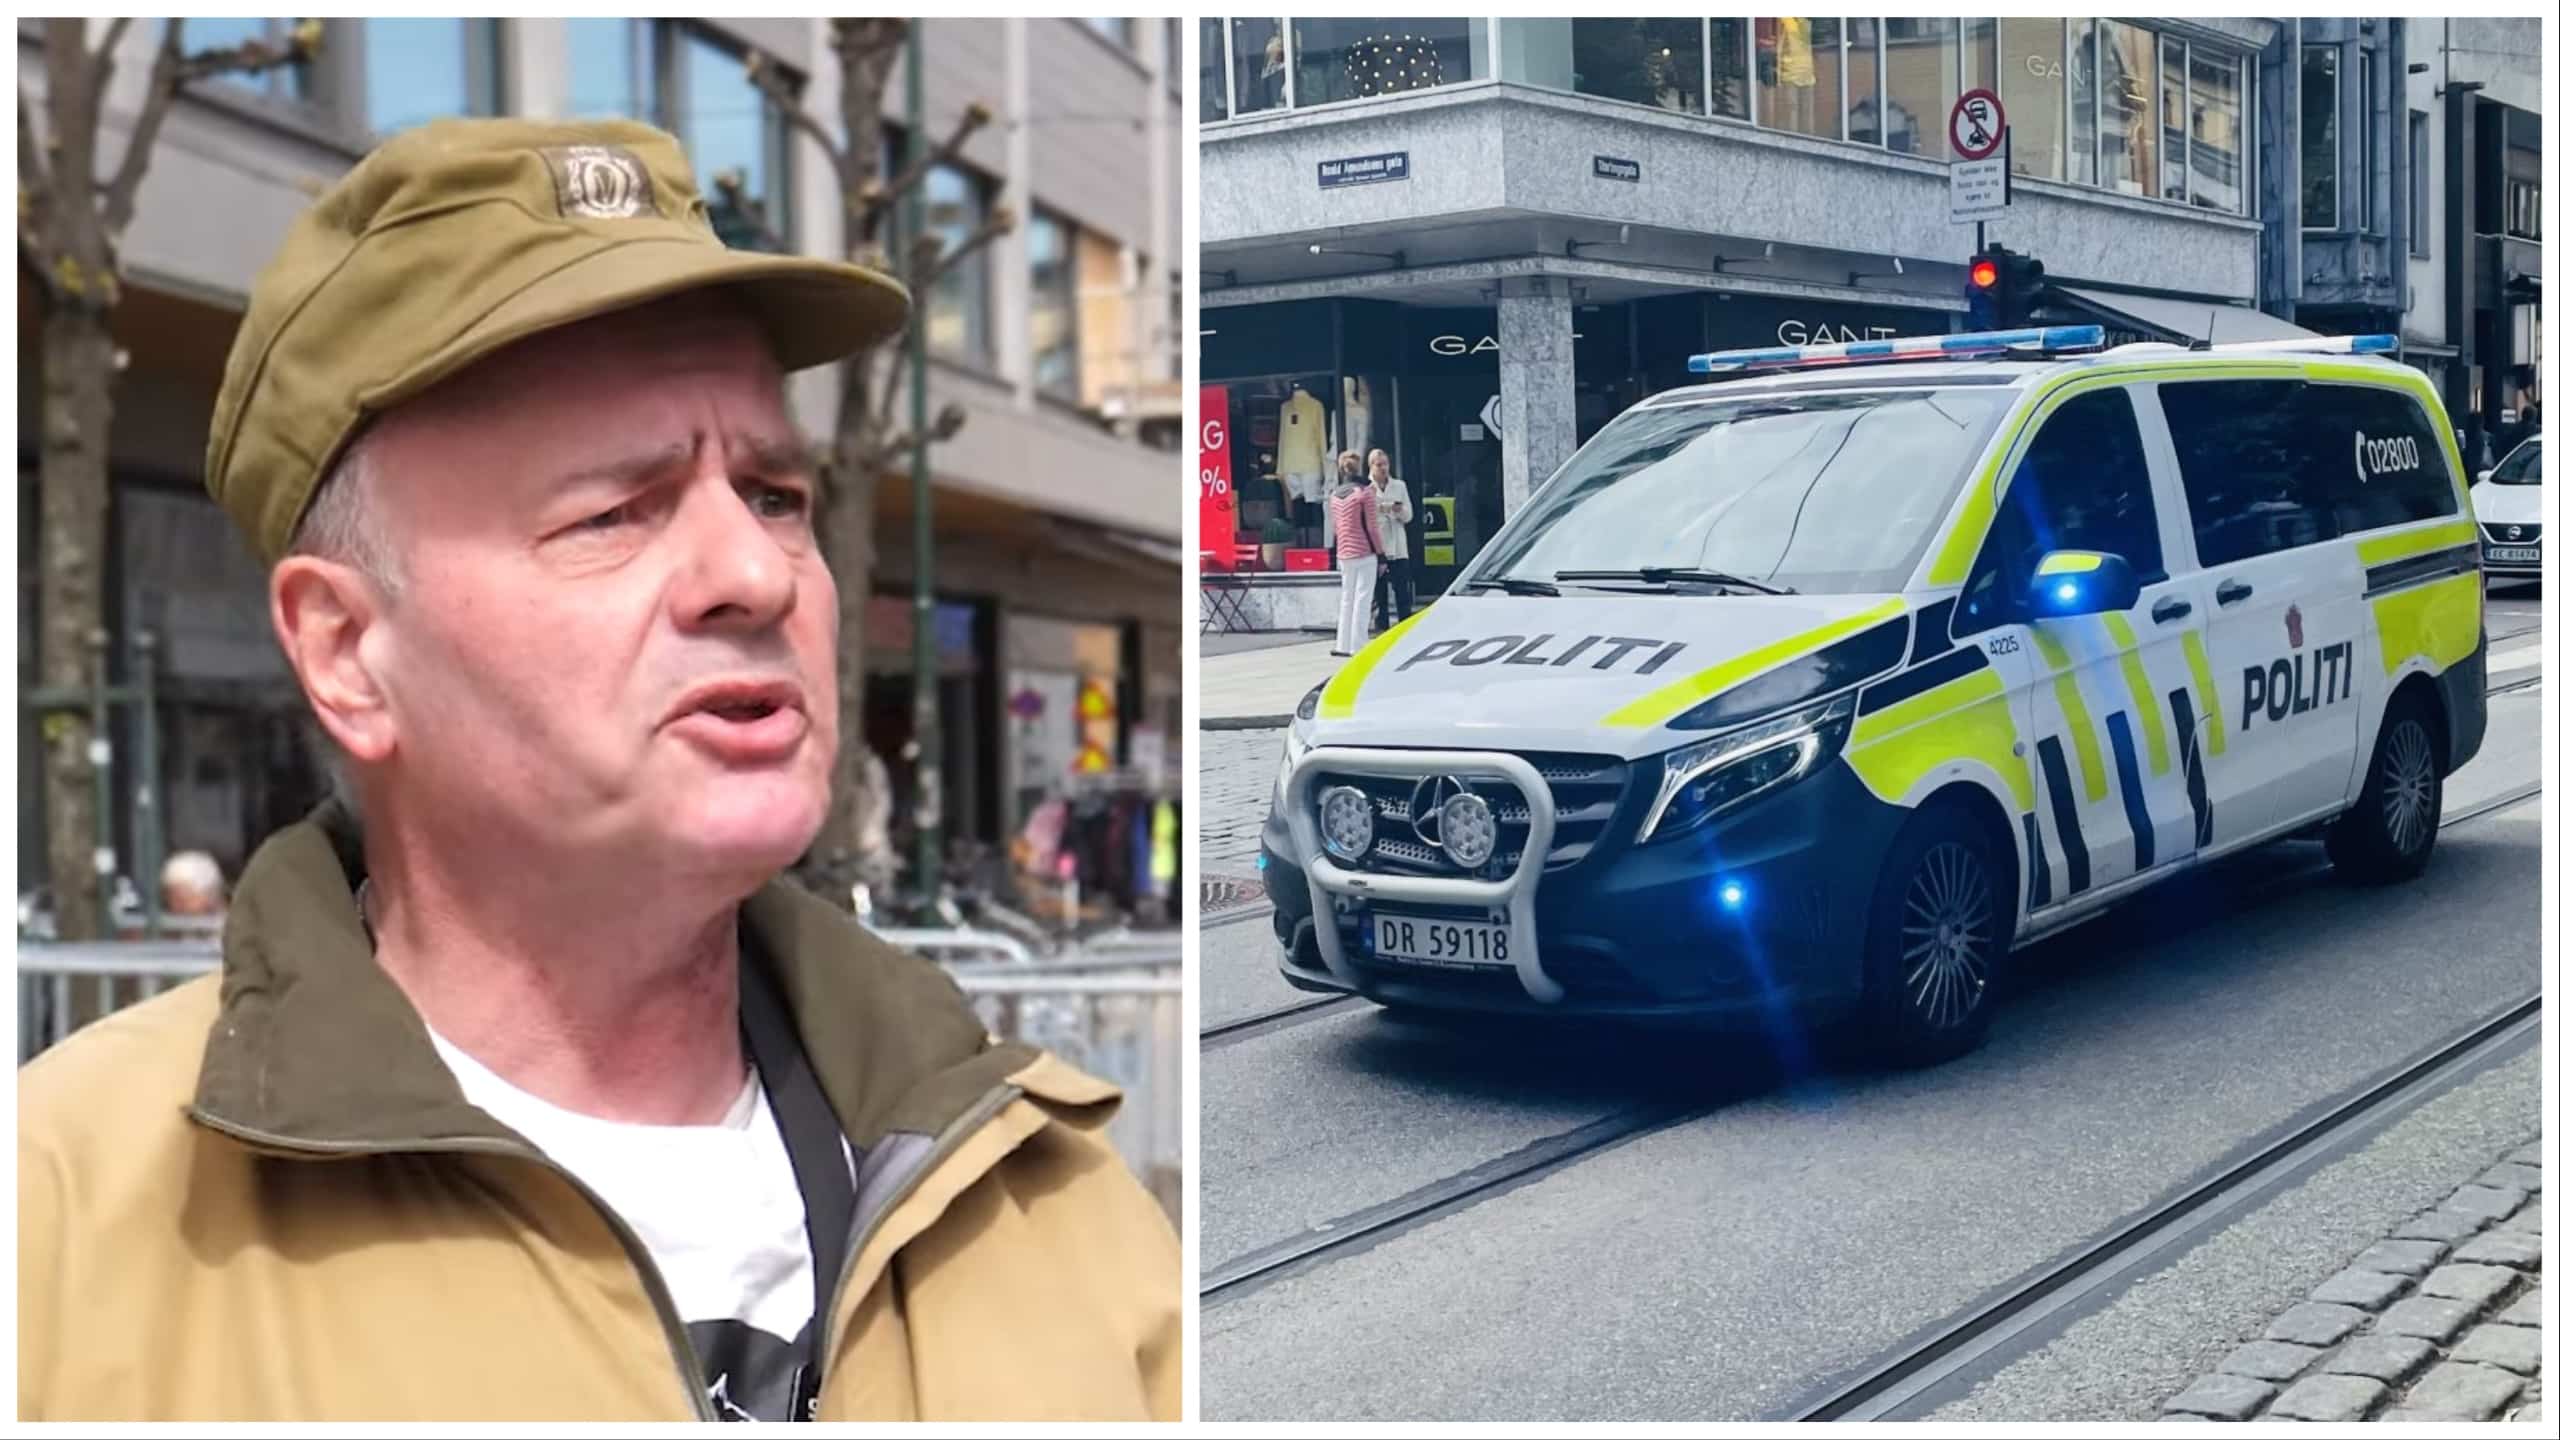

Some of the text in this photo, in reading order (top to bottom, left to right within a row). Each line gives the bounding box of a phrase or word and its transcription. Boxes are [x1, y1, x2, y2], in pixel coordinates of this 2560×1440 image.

[2367, 435, 2419, 474] 02800
[1393, 633, 1689, 675] POLITI
[1990, 635, 2019, 656] 4225
[2242, 640, 2353, 731] POLITI
[1382, 919, 1508, 961] DR 59118
